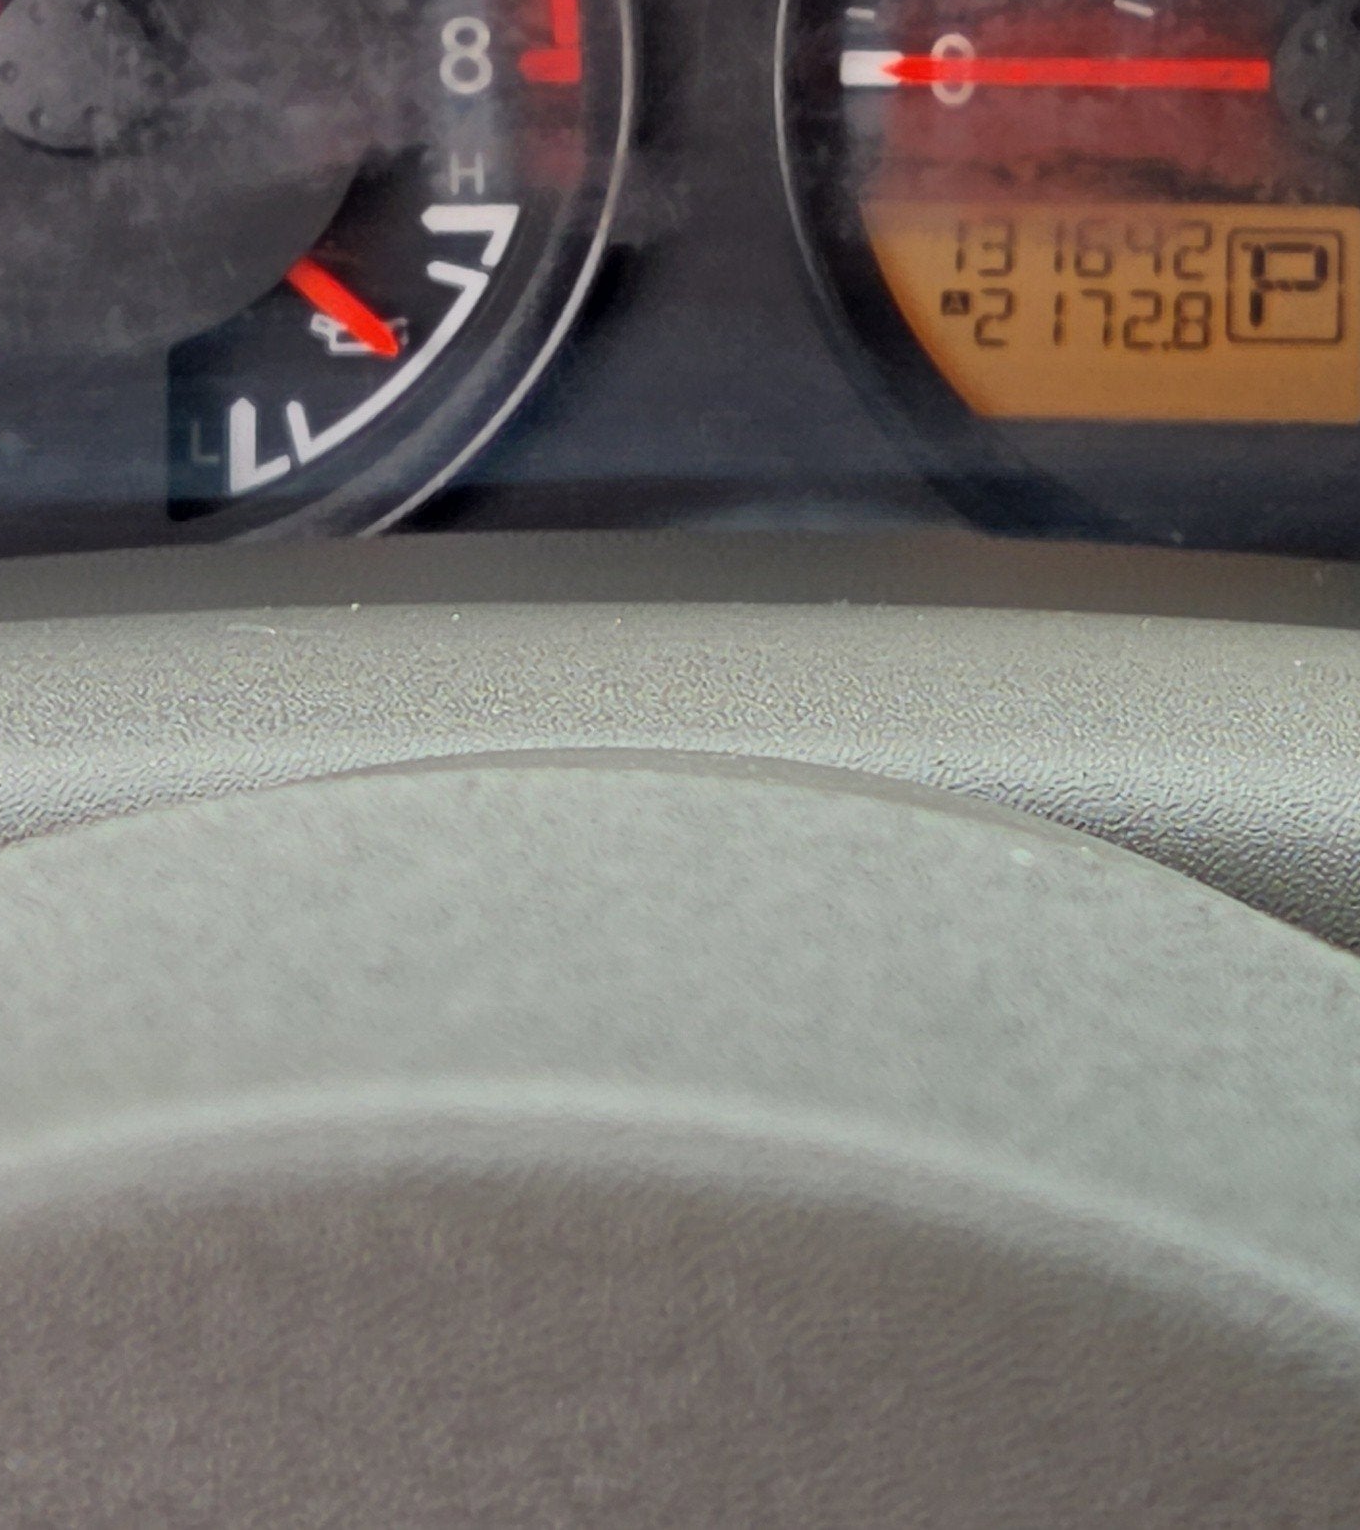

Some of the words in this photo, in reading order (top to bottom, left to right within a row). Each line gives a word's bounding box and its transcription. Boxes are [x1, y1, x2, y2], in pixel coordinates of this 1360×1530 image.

[439, 15, 493, 96] 8
[931, 32, 975, 105] 0
[449, 152, 485, 196] H
[954, 218, 1214, 279] 131642
[1245, 241, 1330, 328] P
